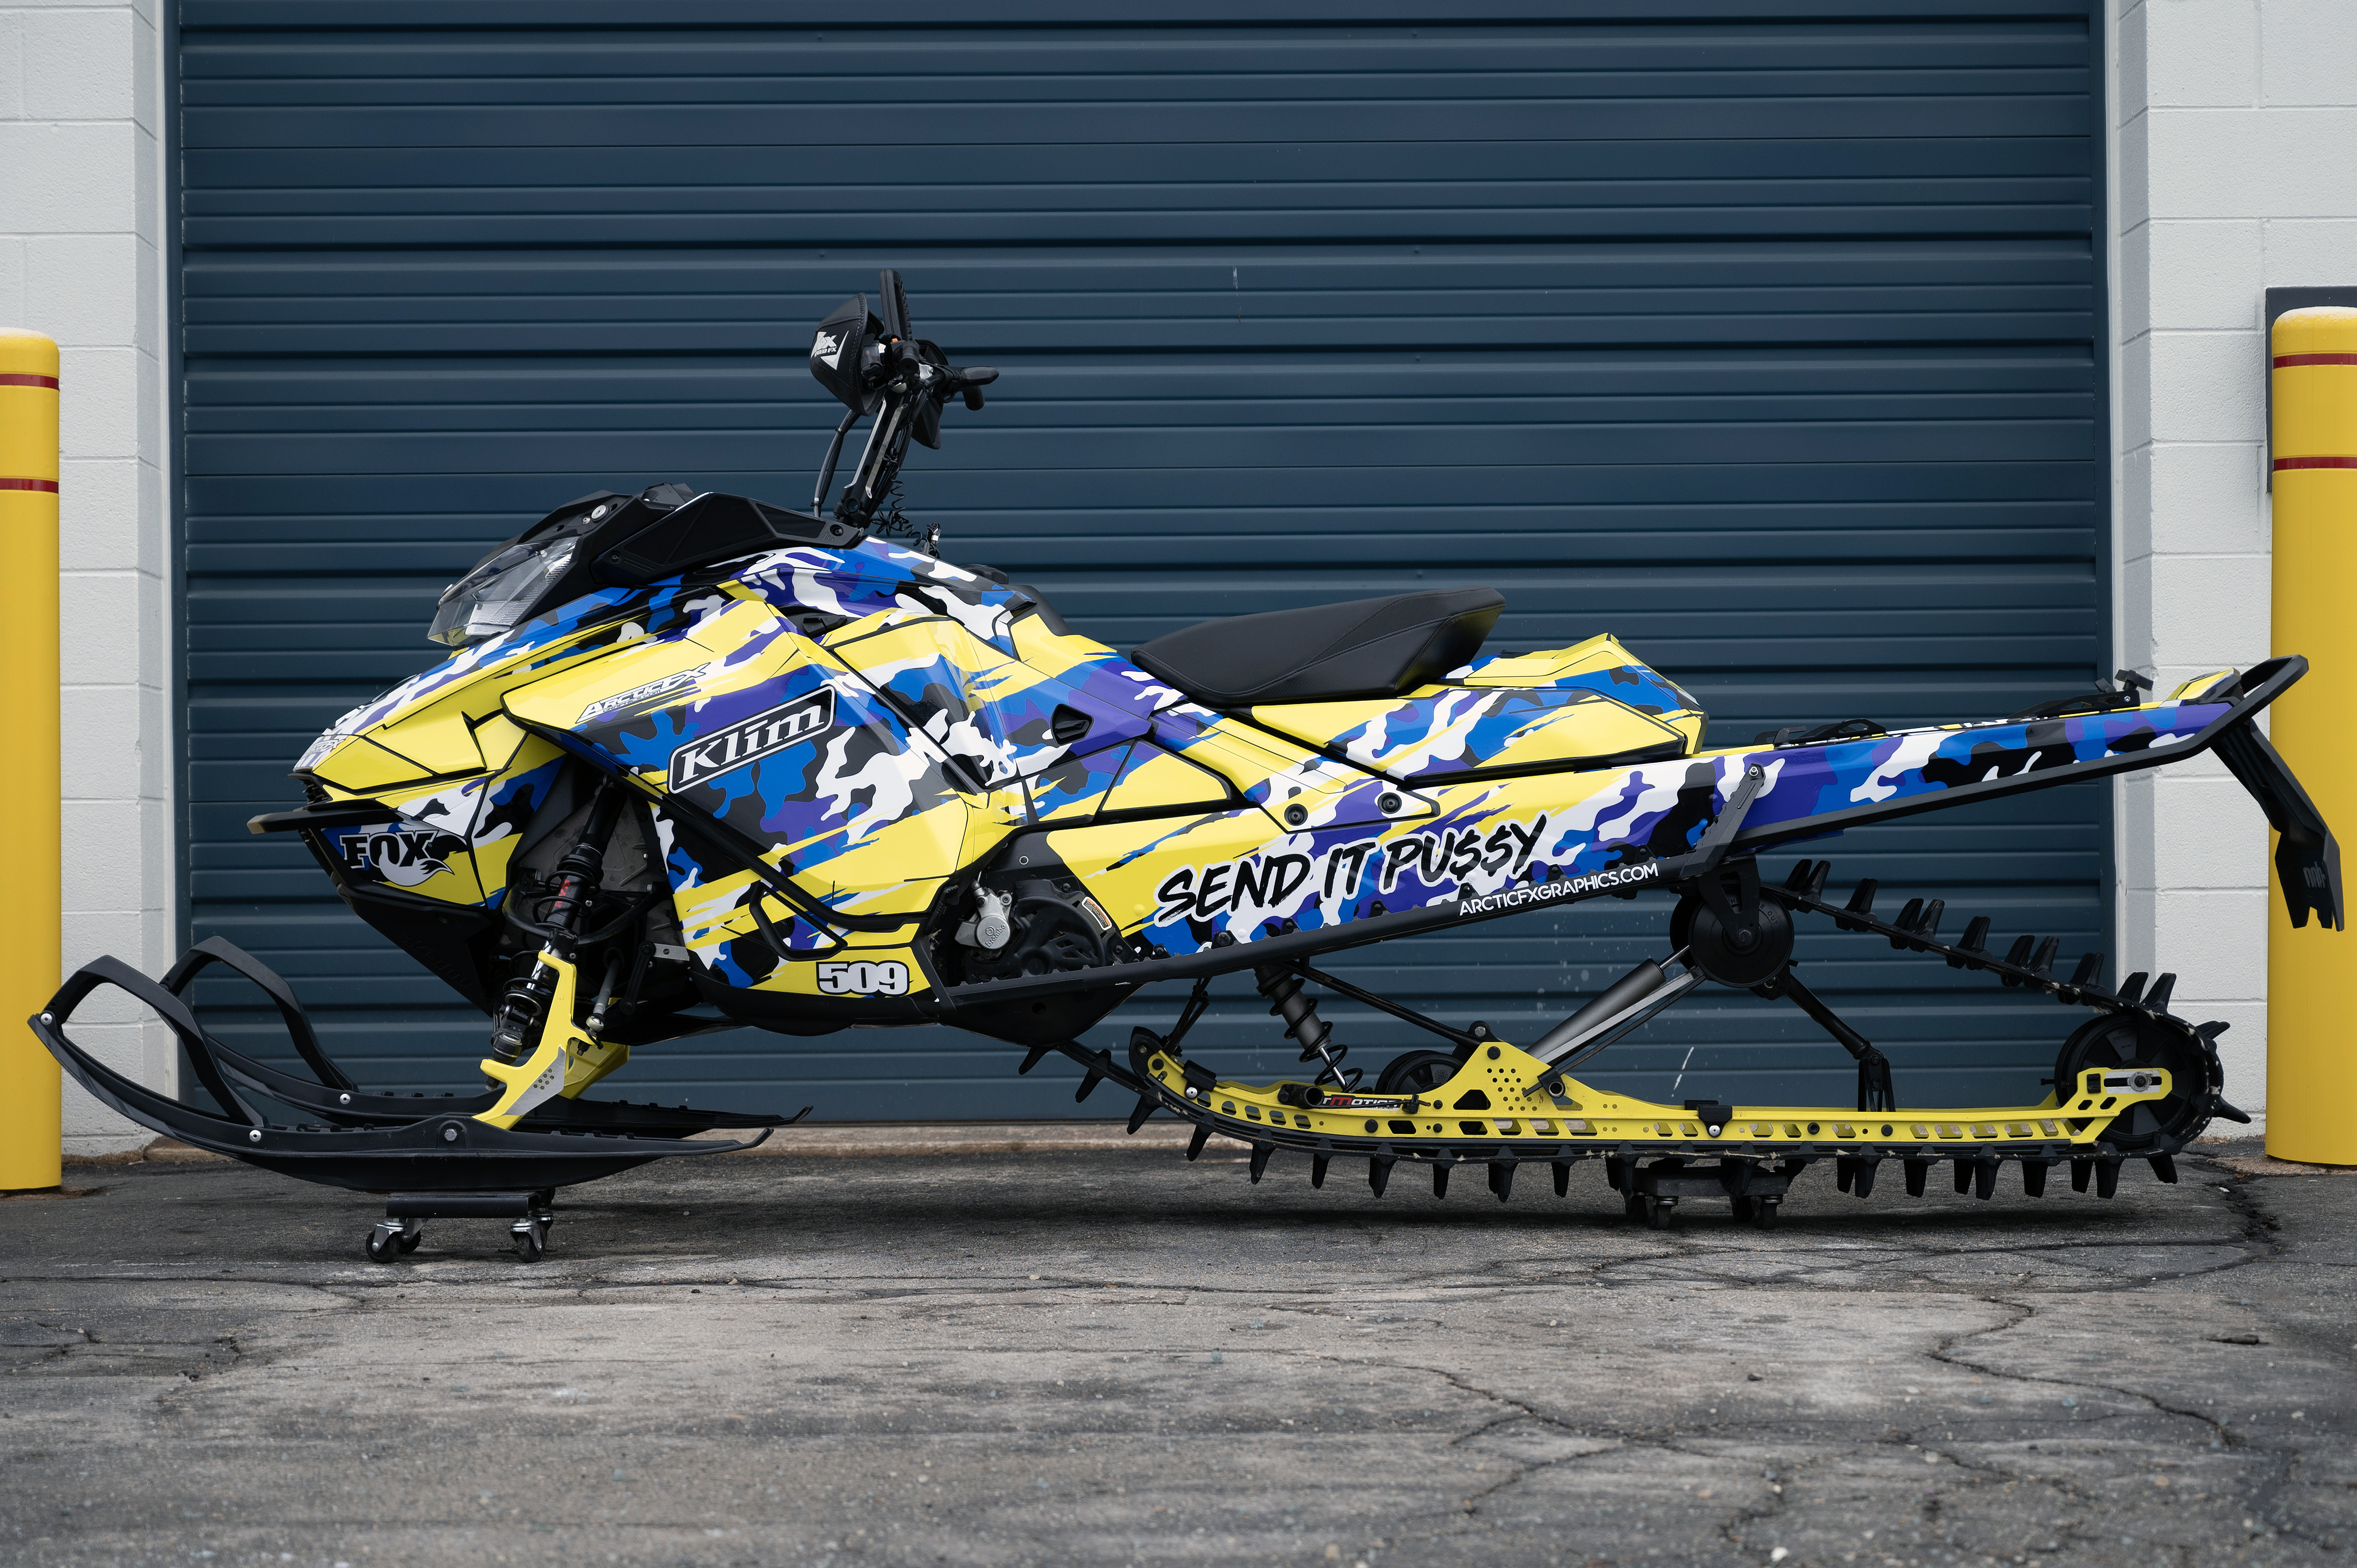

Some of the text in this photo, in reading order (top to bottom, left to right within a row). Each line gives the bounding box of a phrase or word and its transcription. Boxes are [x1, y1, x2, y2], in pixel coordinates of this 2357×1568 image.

[339, 830, 439, 869] FOX
[1158, 853, 1311, 923] SEND
[1324, 841, 1376, 898] IT
[1386, 814, 1547, 890] PU$$Y
[1459, 862, 1658, 916] ARCTICFXGRAPHICS.COM
[985, 924, 1006, 947] brembo
[1767, 911, 1778, 925] OUT
[818, 962, 908, 995] 509
